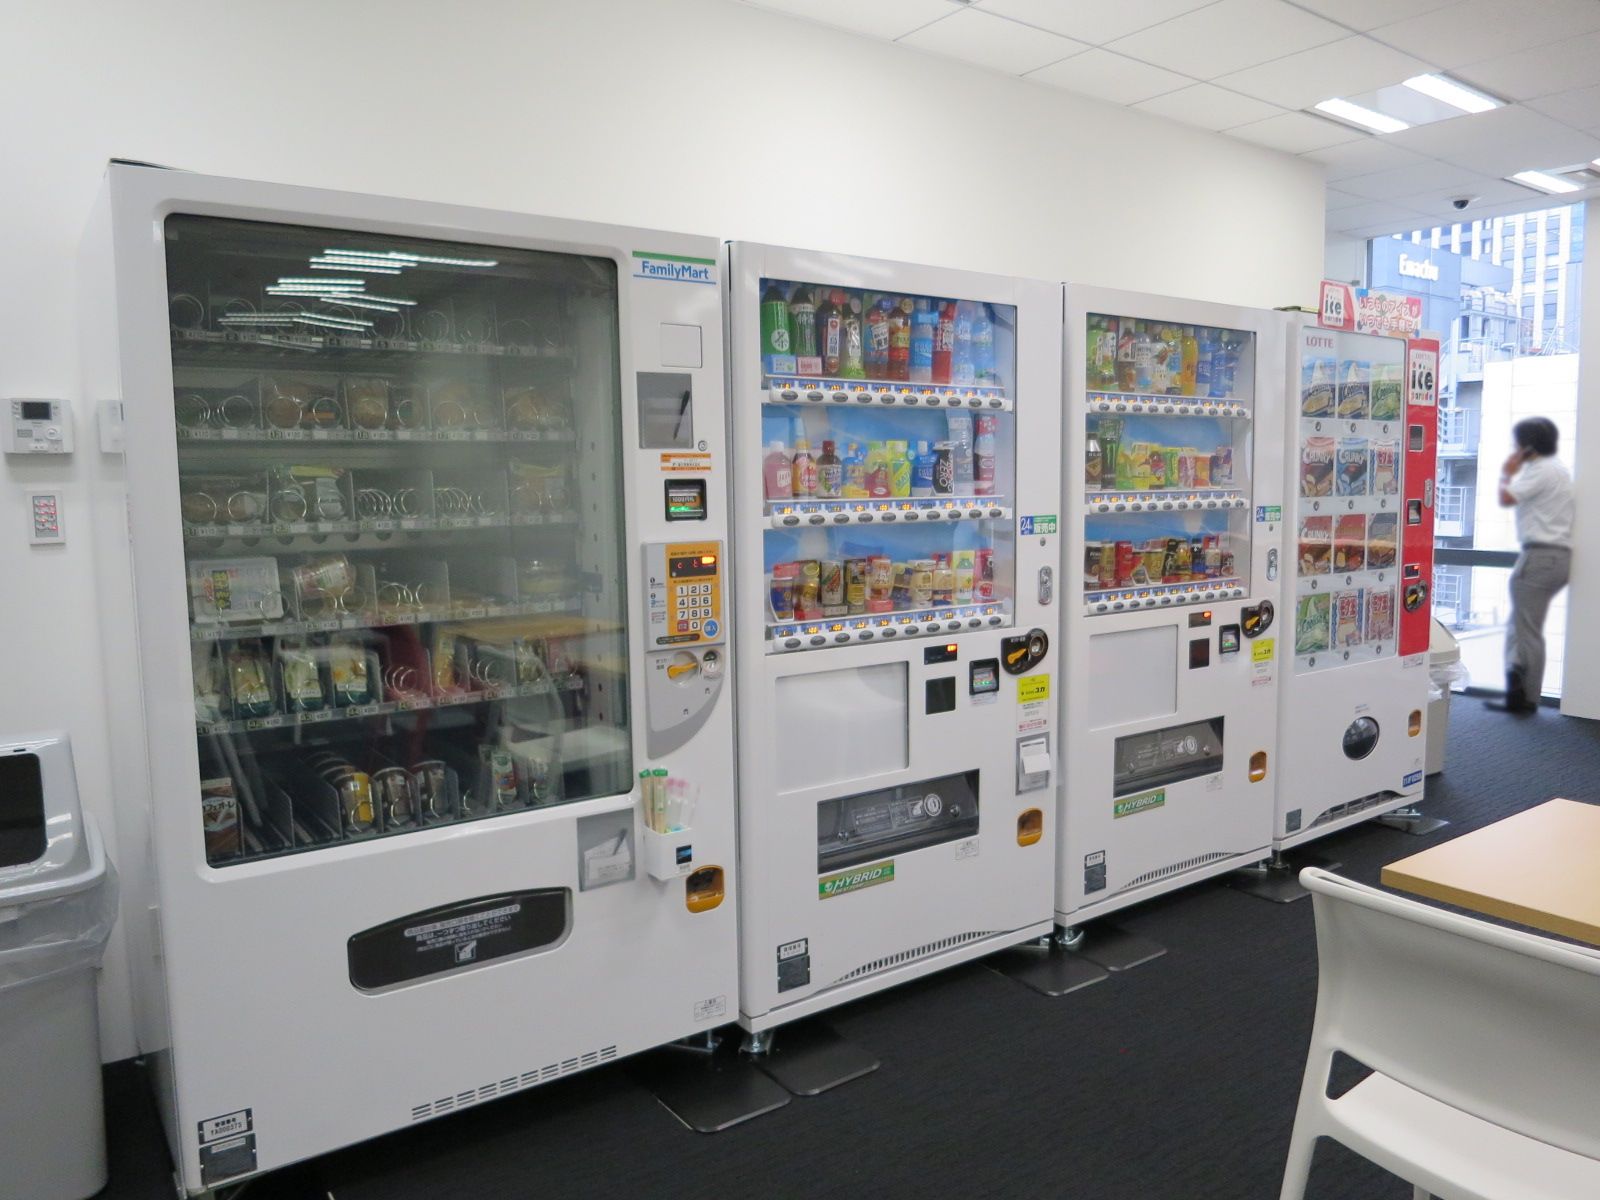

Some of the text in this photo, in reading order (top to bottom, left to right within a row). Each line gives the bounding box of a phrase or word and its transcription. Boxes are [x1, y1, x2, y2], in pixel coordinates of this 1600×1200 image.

[641, 260, 709, 280] FamilyMart
[1324, 294, 1342, 315] ice
[1306, 335, 1334, 348] LOTTE
[1411, 361, 1433, 391] ice
[939, 458, 949, 488] ZERO
[1021, 517, 1031, 530] 24
[1124, 795, 1157, 813] HYBRID
[832, 868, 882, 894] HYBRID
